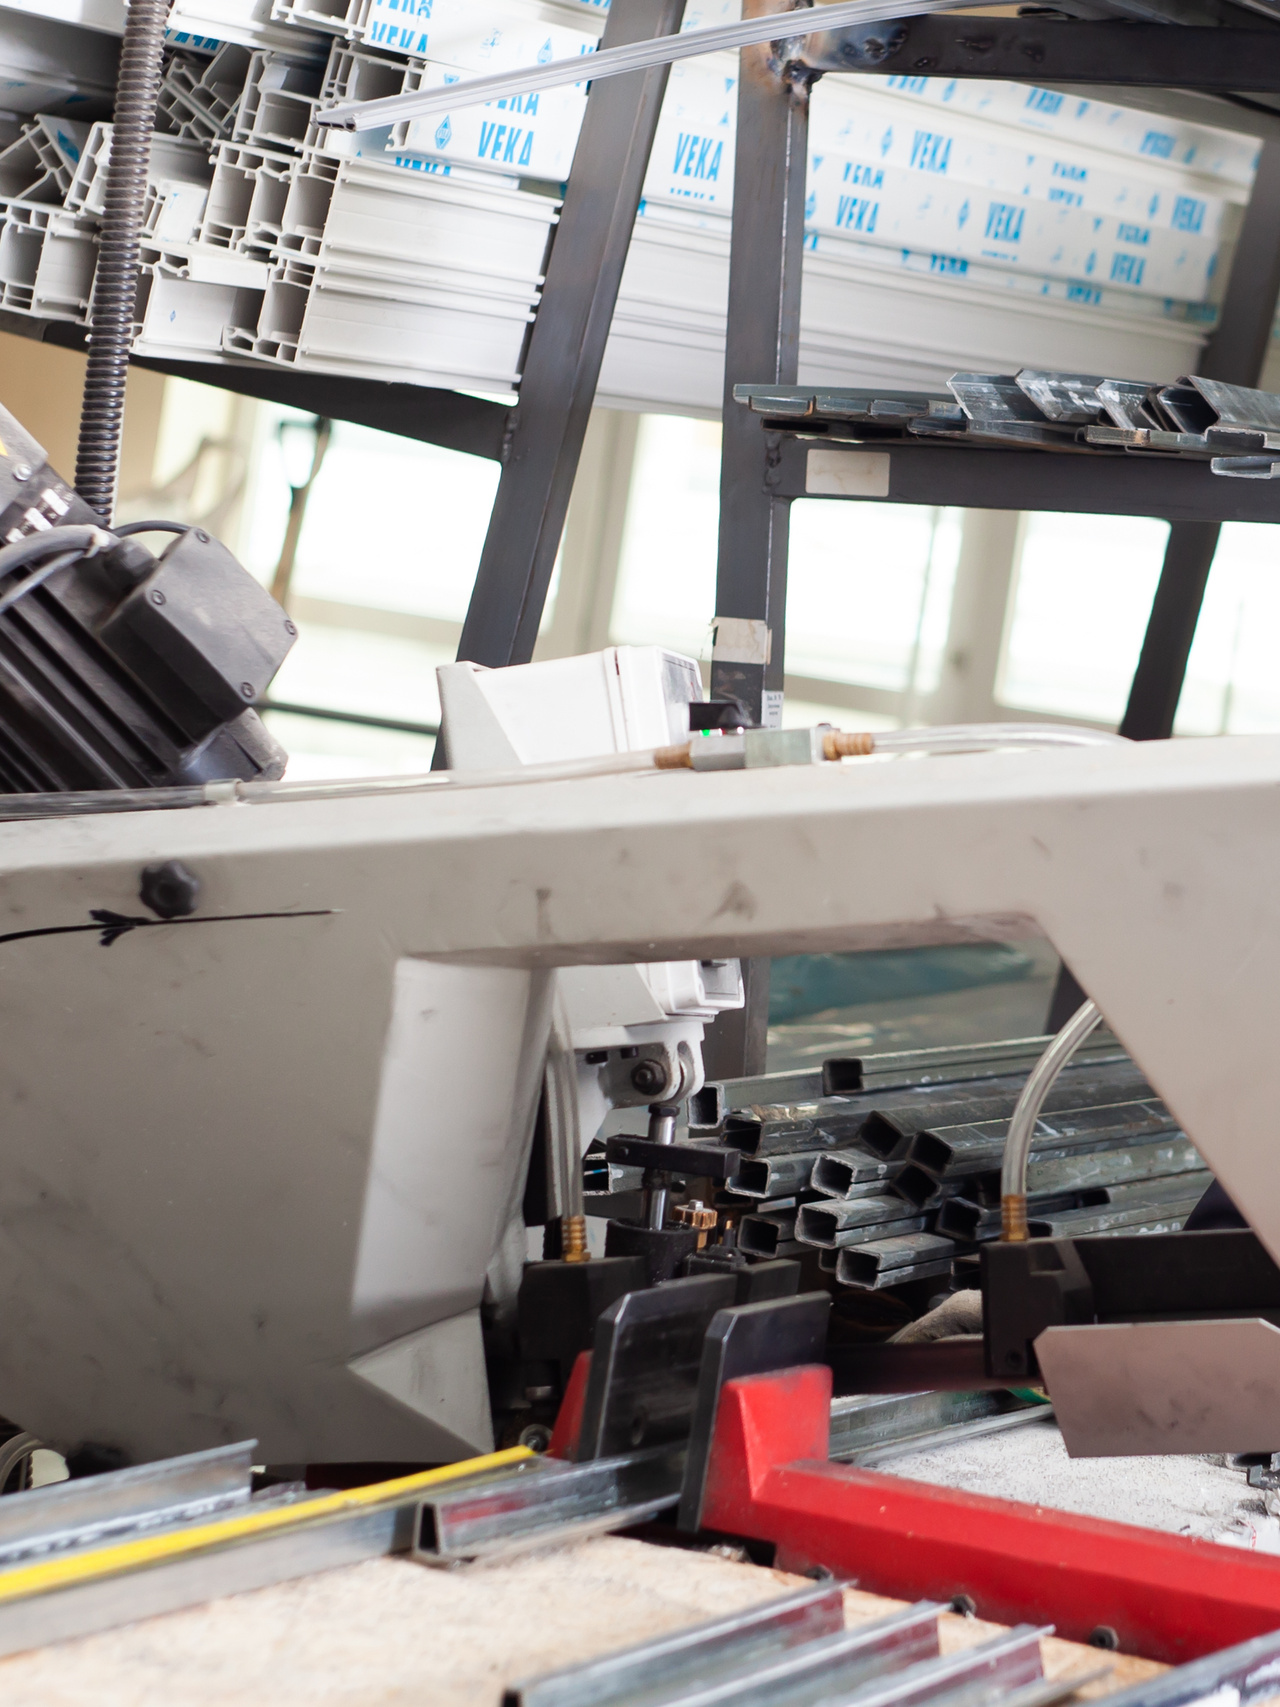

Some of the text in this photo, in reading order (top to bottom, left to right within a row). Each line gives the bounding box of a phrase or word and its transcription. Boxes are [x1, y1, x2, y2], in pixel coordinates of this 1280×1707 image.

[477, 121, 534, 166] VEKA
[672, 132, 724, 181] VEKA
[910, 130, 953, 174] VEKA
[836, 195, 880, 234] VEKA
